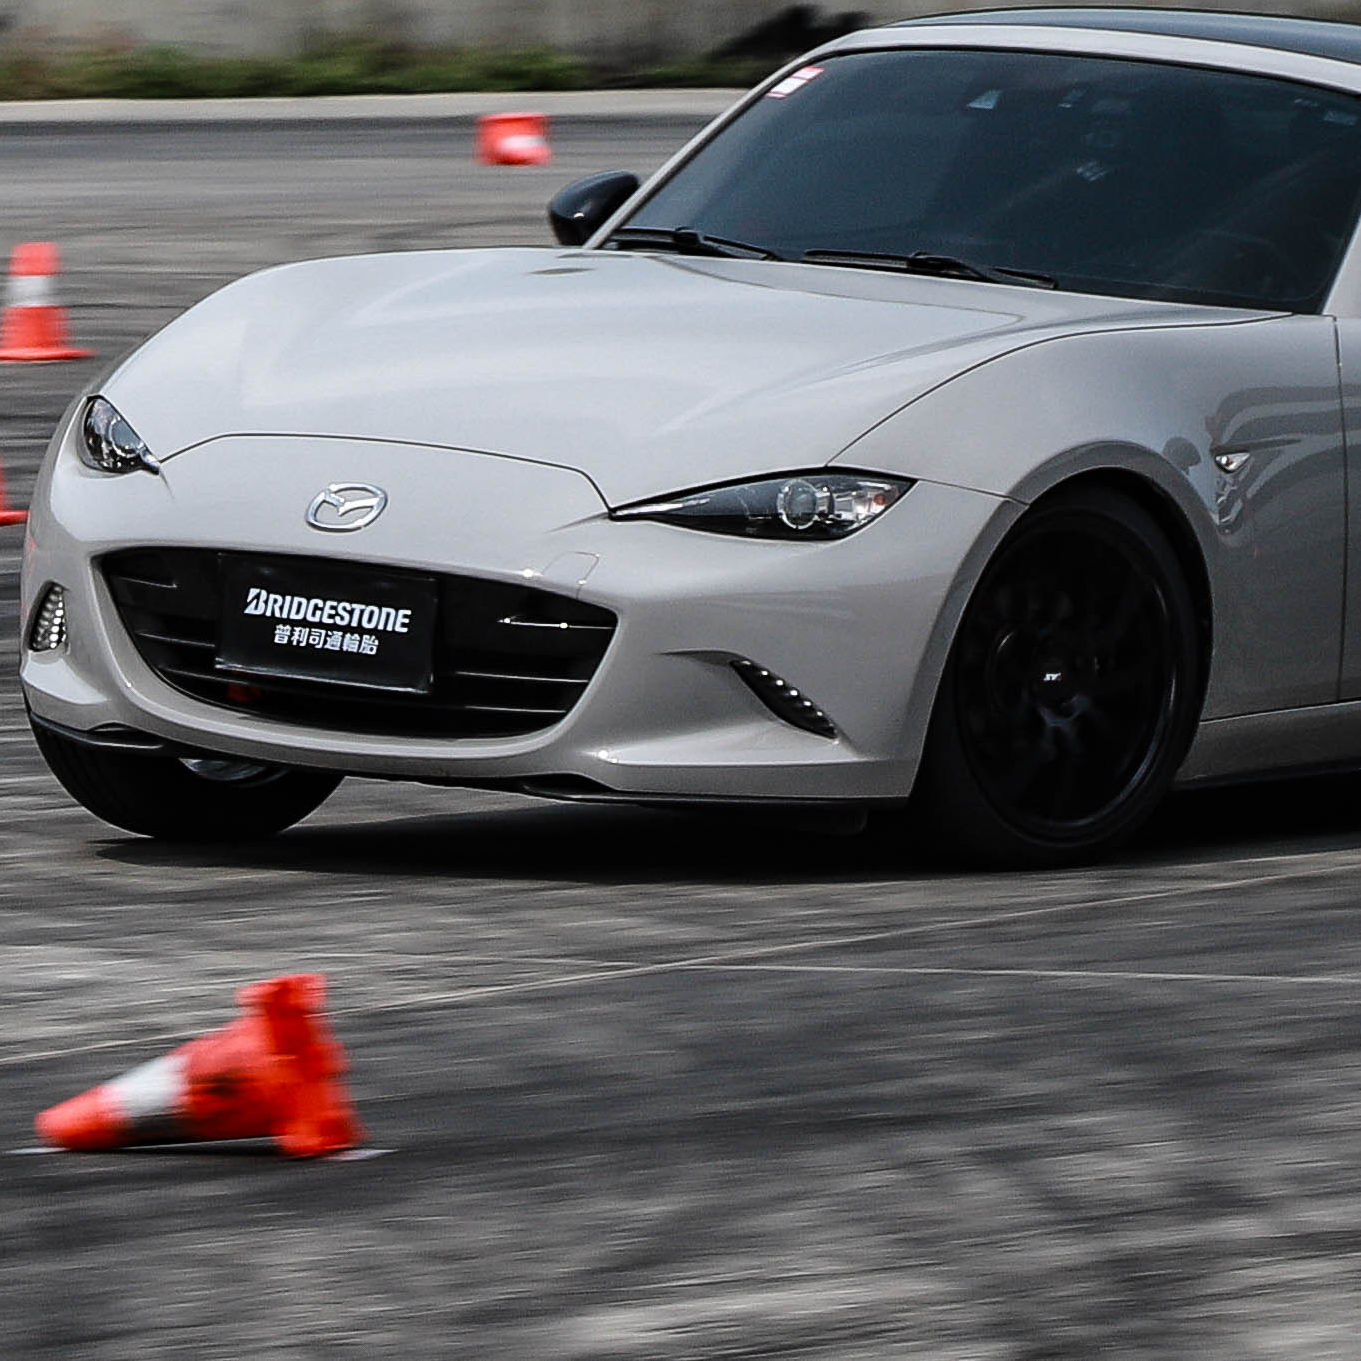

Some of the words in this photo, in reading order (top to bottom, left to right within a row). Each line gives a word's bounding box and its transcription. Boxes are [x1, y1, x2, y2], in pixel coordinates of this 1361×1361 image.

[244, 588, 412, 633] BRIDGESTONE
[274, 624, 379, 655] 普利司通輪胎
